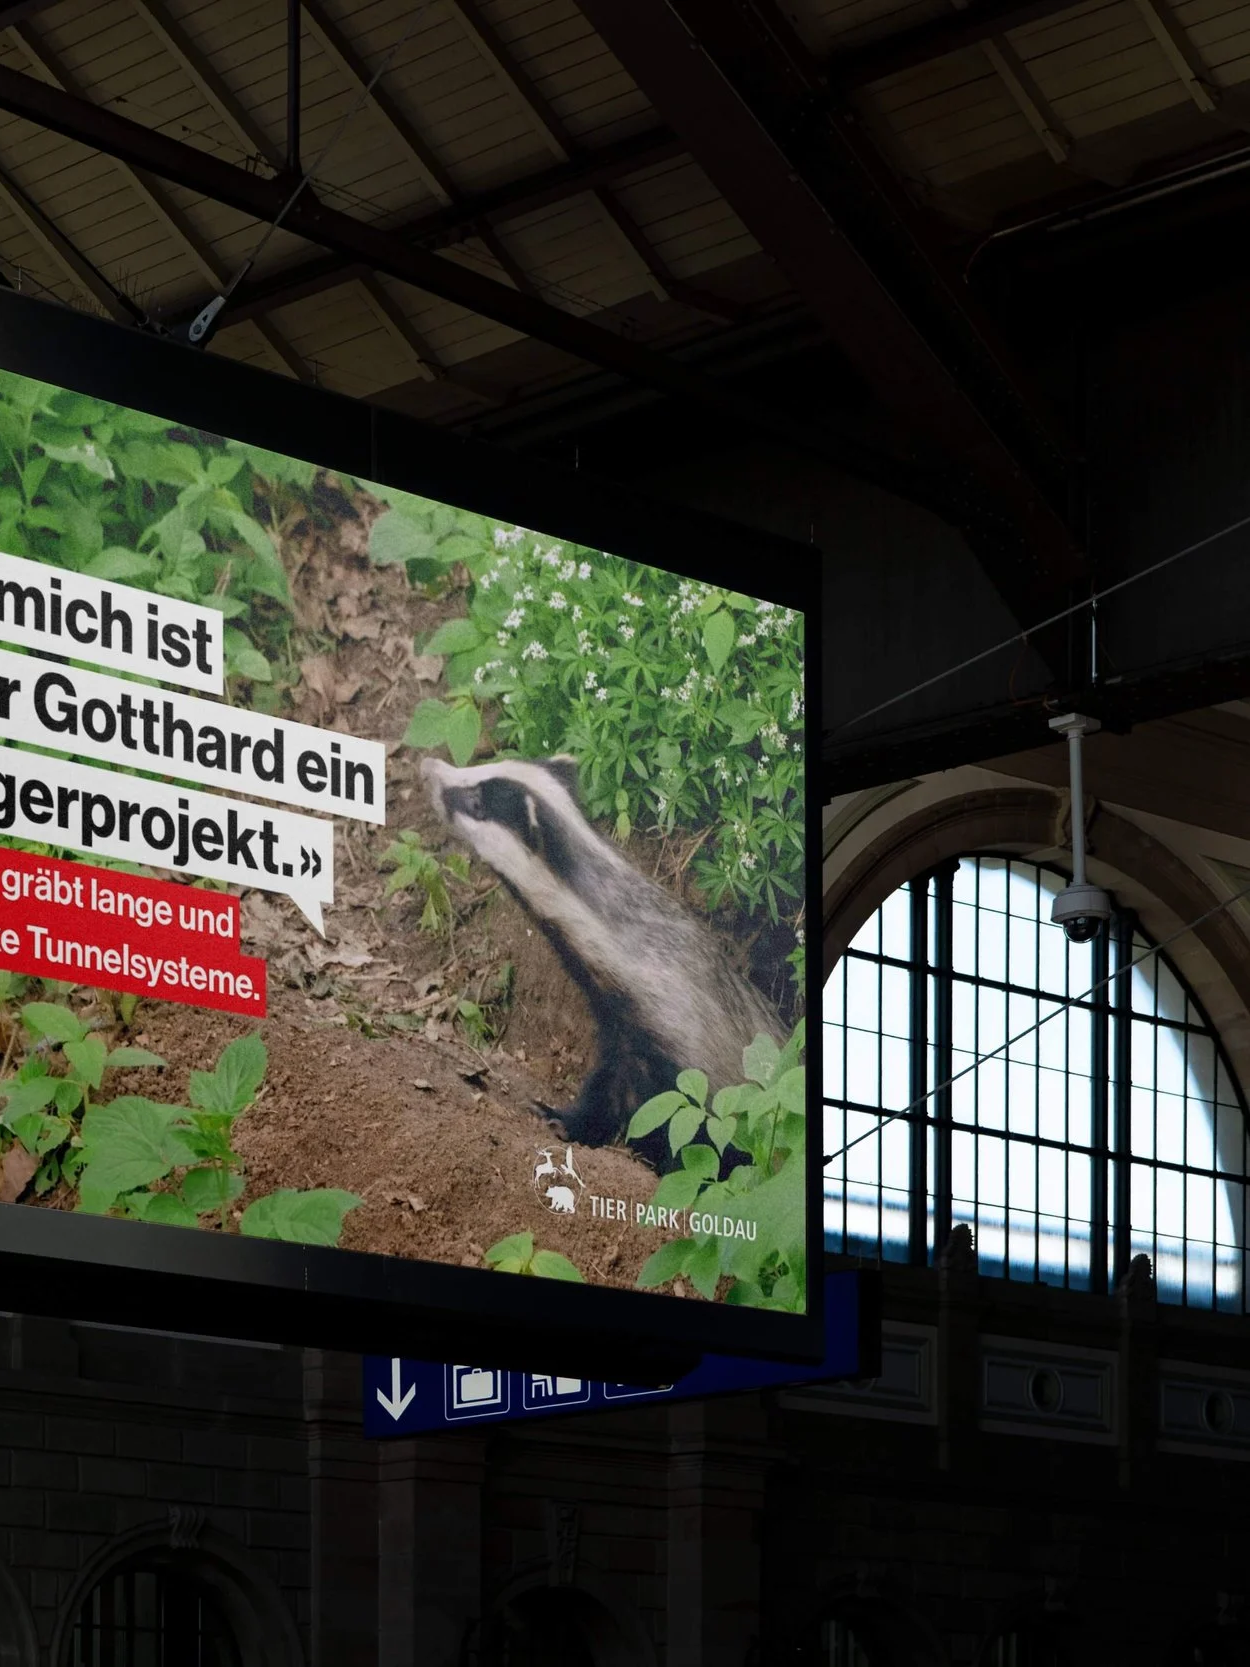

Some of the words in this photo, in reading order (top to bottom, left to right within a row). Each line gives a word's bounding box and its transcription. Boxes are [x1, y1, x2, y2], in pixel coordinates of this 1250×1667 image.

[147, 603, 214, 675] ist
[34, 671, 285, 785] Gotthard
[296, 741, 375, 806] ein
[2, 862, 84, 909] gräbt
[90, 878, 173, 930] lange
[178, 891, 235, 938] und
[26, 923, 261, 1001] Tunnelsysteme.
[589, 1195, 627, 1222] TIER
[636, 1203, 680, 1230] PARK
[689, 1211, 757, 1241] GOLDAU
